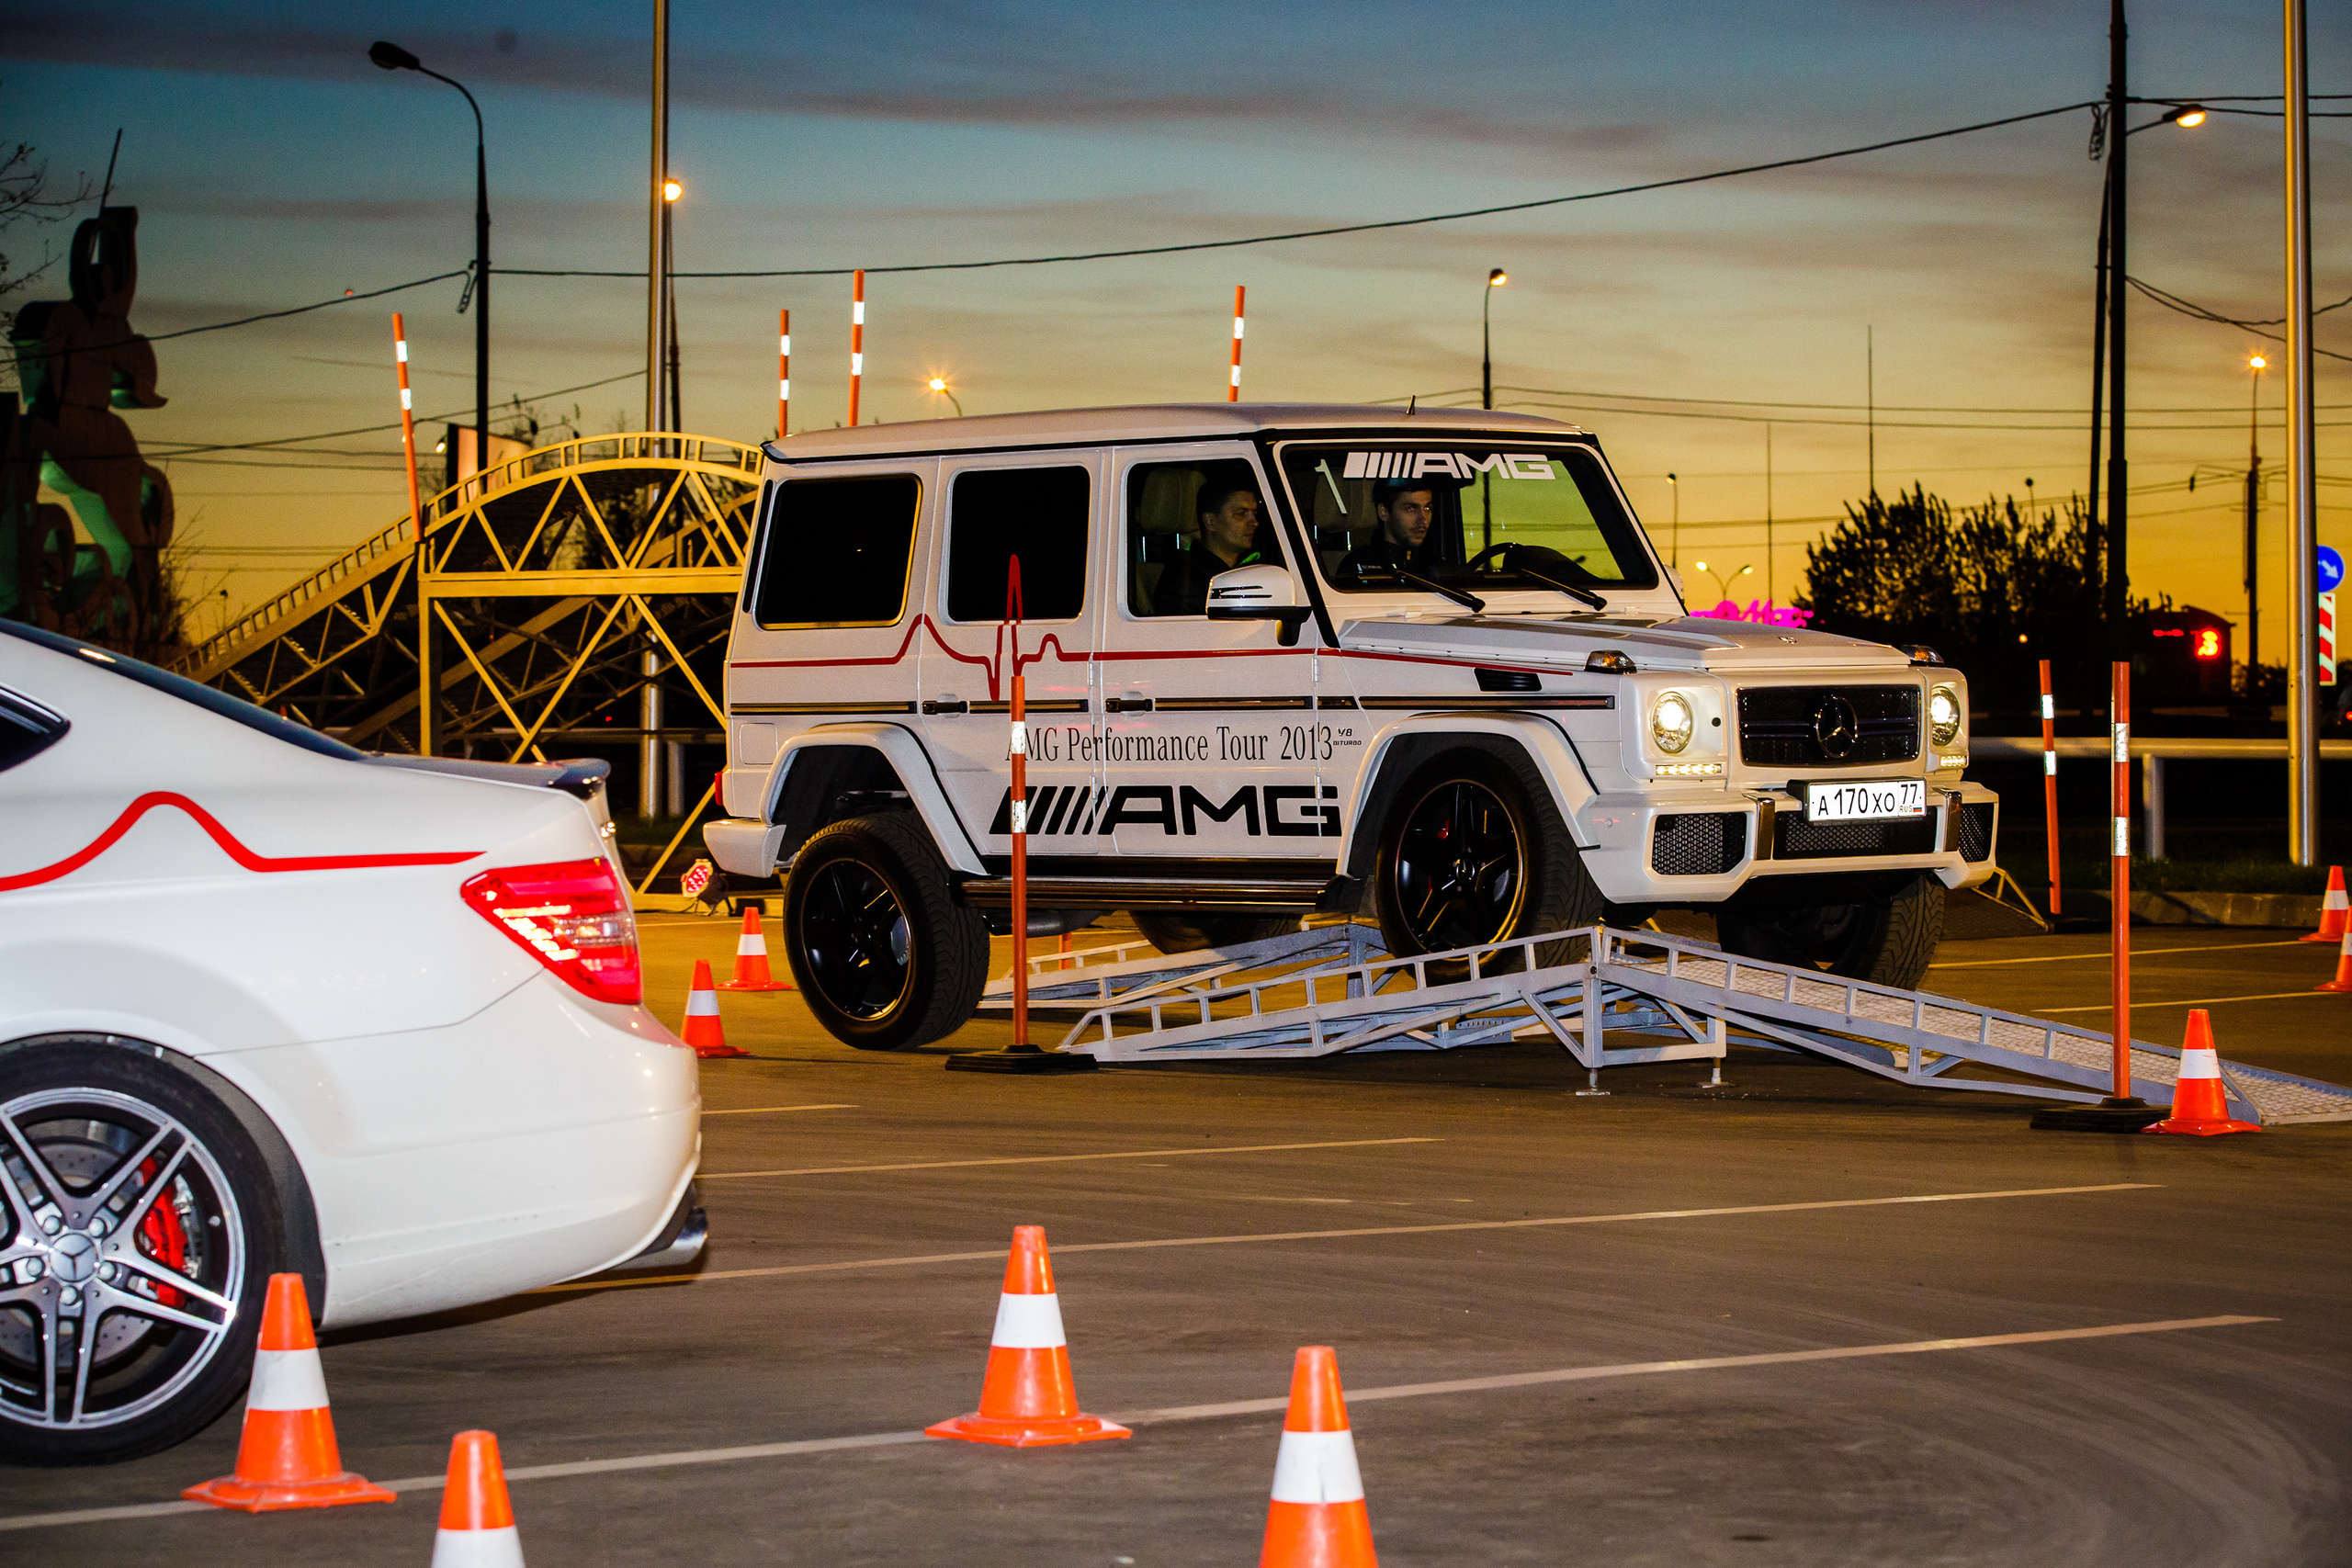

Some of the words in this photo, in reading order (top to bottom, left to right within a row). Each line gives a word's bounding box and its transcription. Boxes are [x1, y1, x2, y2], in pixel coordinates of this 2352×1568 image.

[1337, 728, 1353, 738] V8
[1067, 724, 1209, 761] Performance
[1216, 725, 1269, 761] Tour
[1280, 724, 1334, 761] 2013
[1900, 783, 1918, 805] 77
[1899, 805, 1913, 813] RUS
